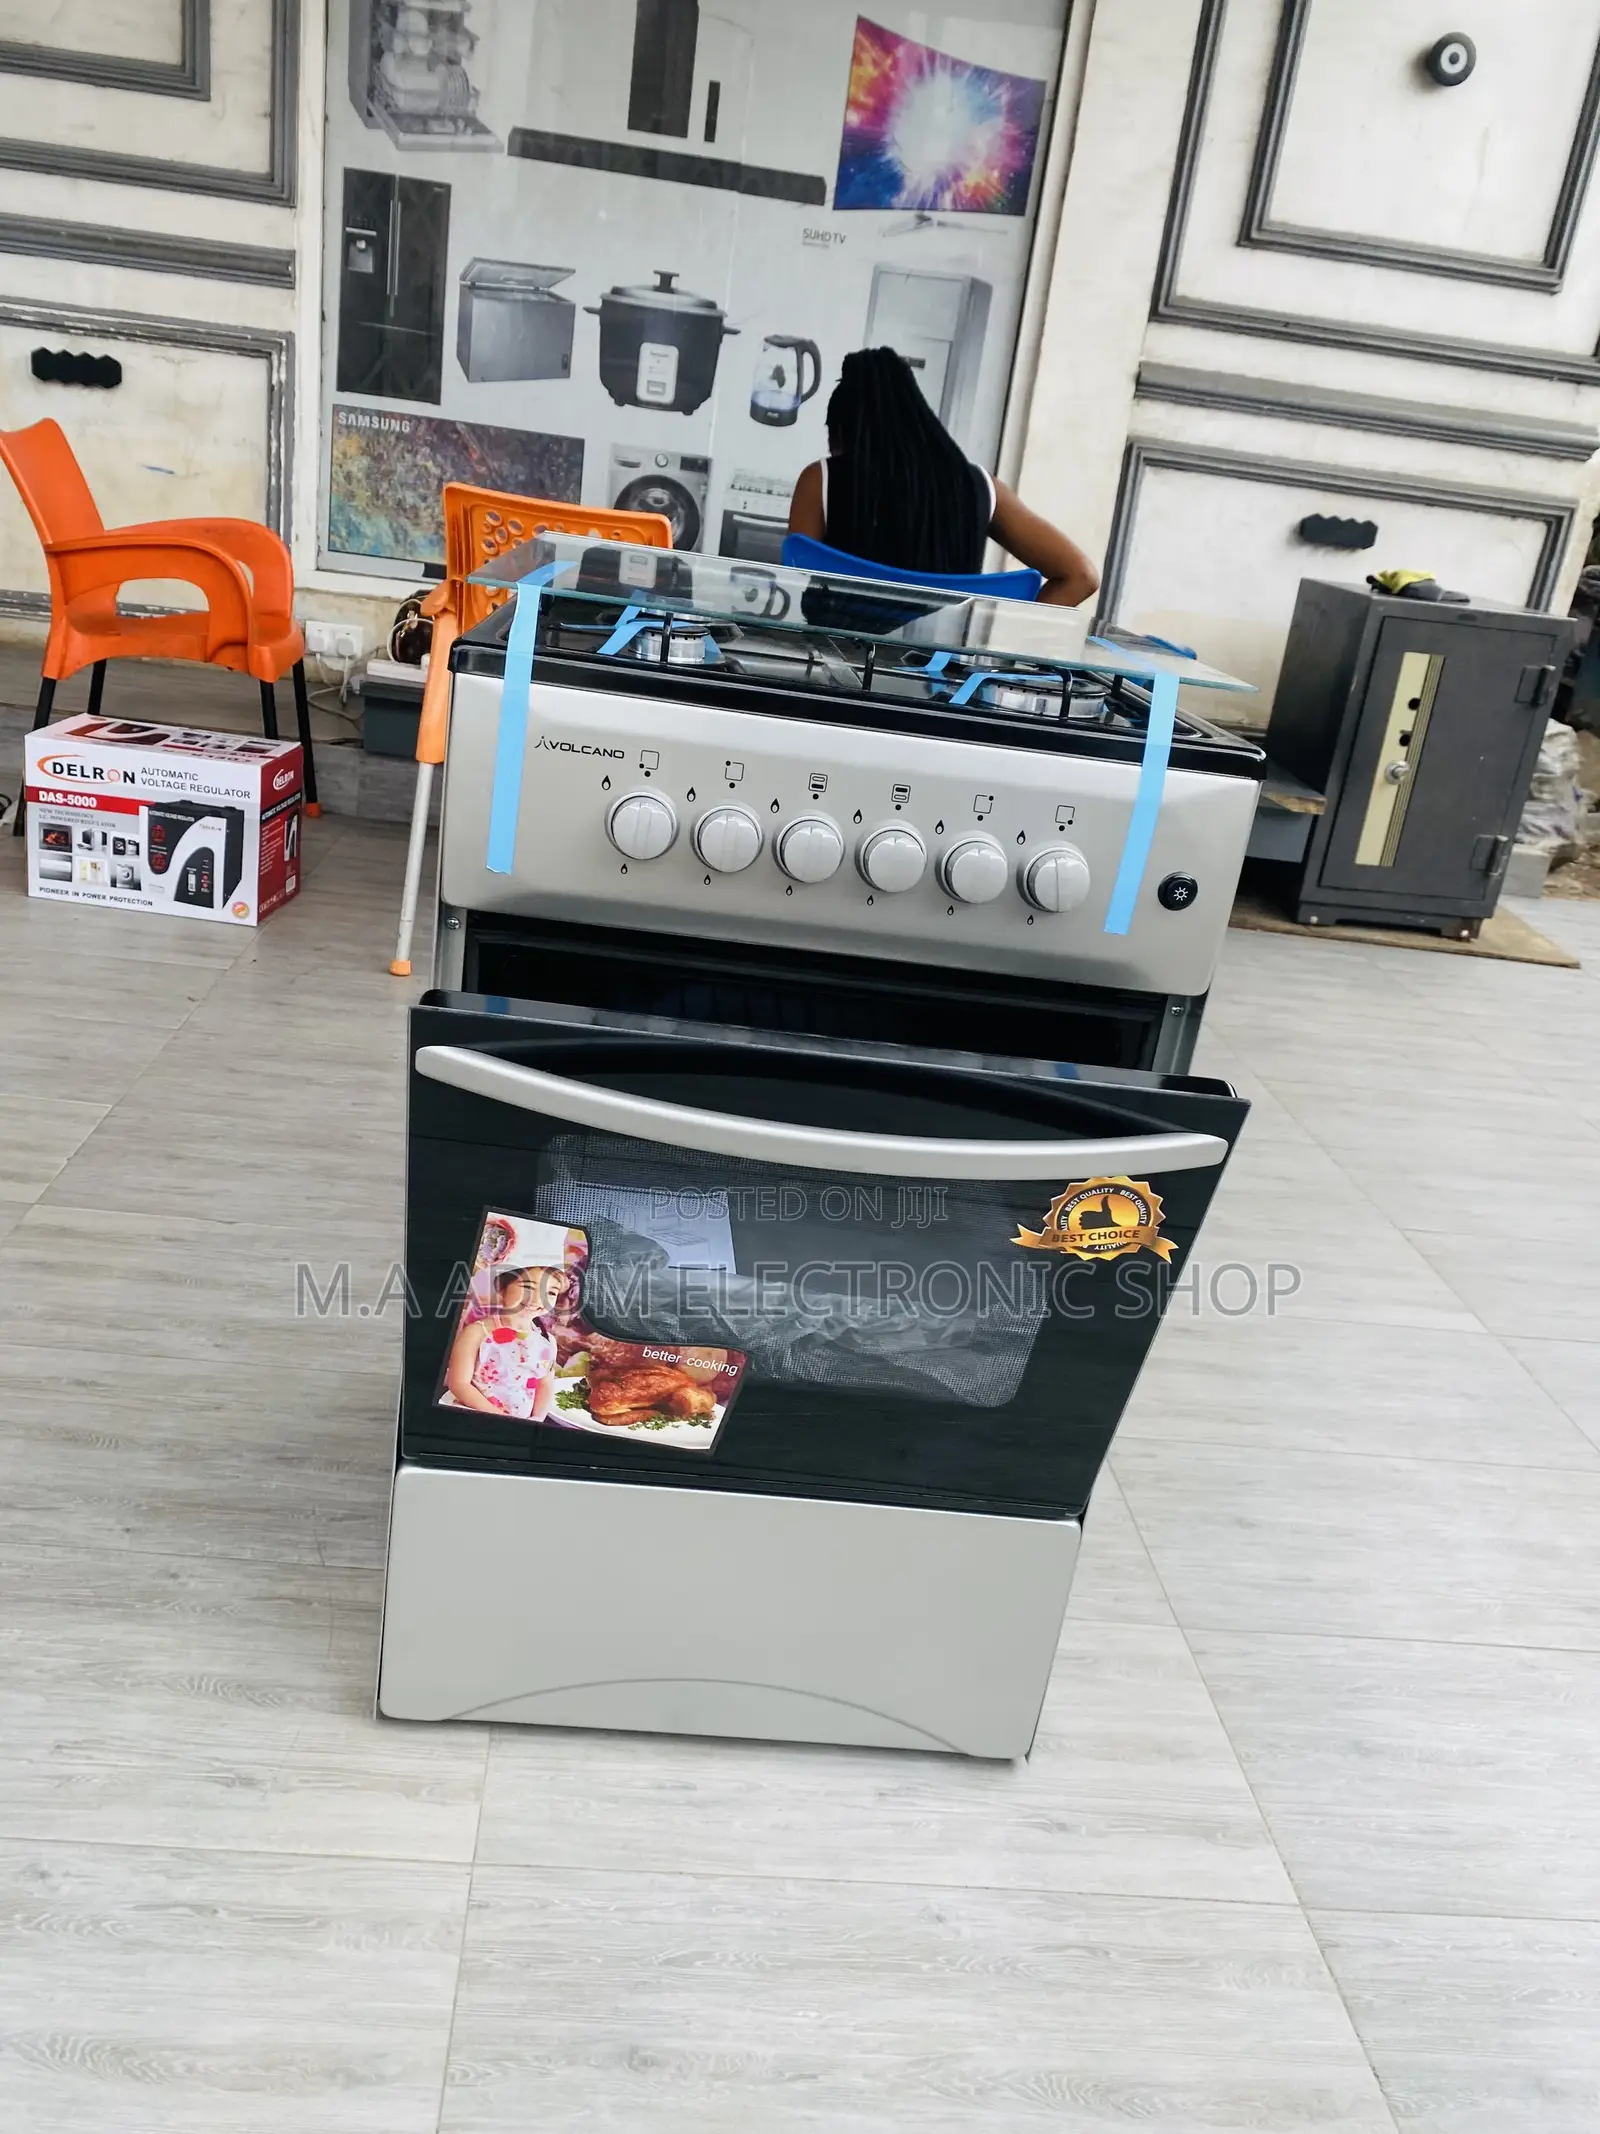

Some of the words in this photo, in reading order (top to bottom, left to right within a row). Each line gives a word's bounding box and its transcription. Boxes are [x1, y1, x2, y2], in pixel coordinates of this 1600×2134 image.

[833, 231, 847, 245] TV
[338, 411, 411, 433] SAMSUNG
[549, 740, 625, 759] VOLCANO
[52, 761, 136, 785] DELRON
[140, 767, 199, 782] AUTOMATIC
[140, 777, 187, 791] VOLTAGE
[189, 783, 251, 799] REGULATOR
[38, 790, 97, 809] DAS-5000
[39, 886, 69, 897] PIONEER
[82, 892, 107, 901] POWER
[109, 895, 153, 907] PROTECTION
[1064, 1197, 1080, 1212] BEST
[1079, 1187, 1115, 1200] QUALITY
[1119, 1189, 1138, 1201] BEST
[1134, 1198, 1149, 1225] QUALITY
[1052, 1233, 1086, 1243] BEST
[1088, 1229, 1141, 1241] CHOICE
[641, 1345, 683, 1365] better
[686, 1353, 739, 1377] cooking
